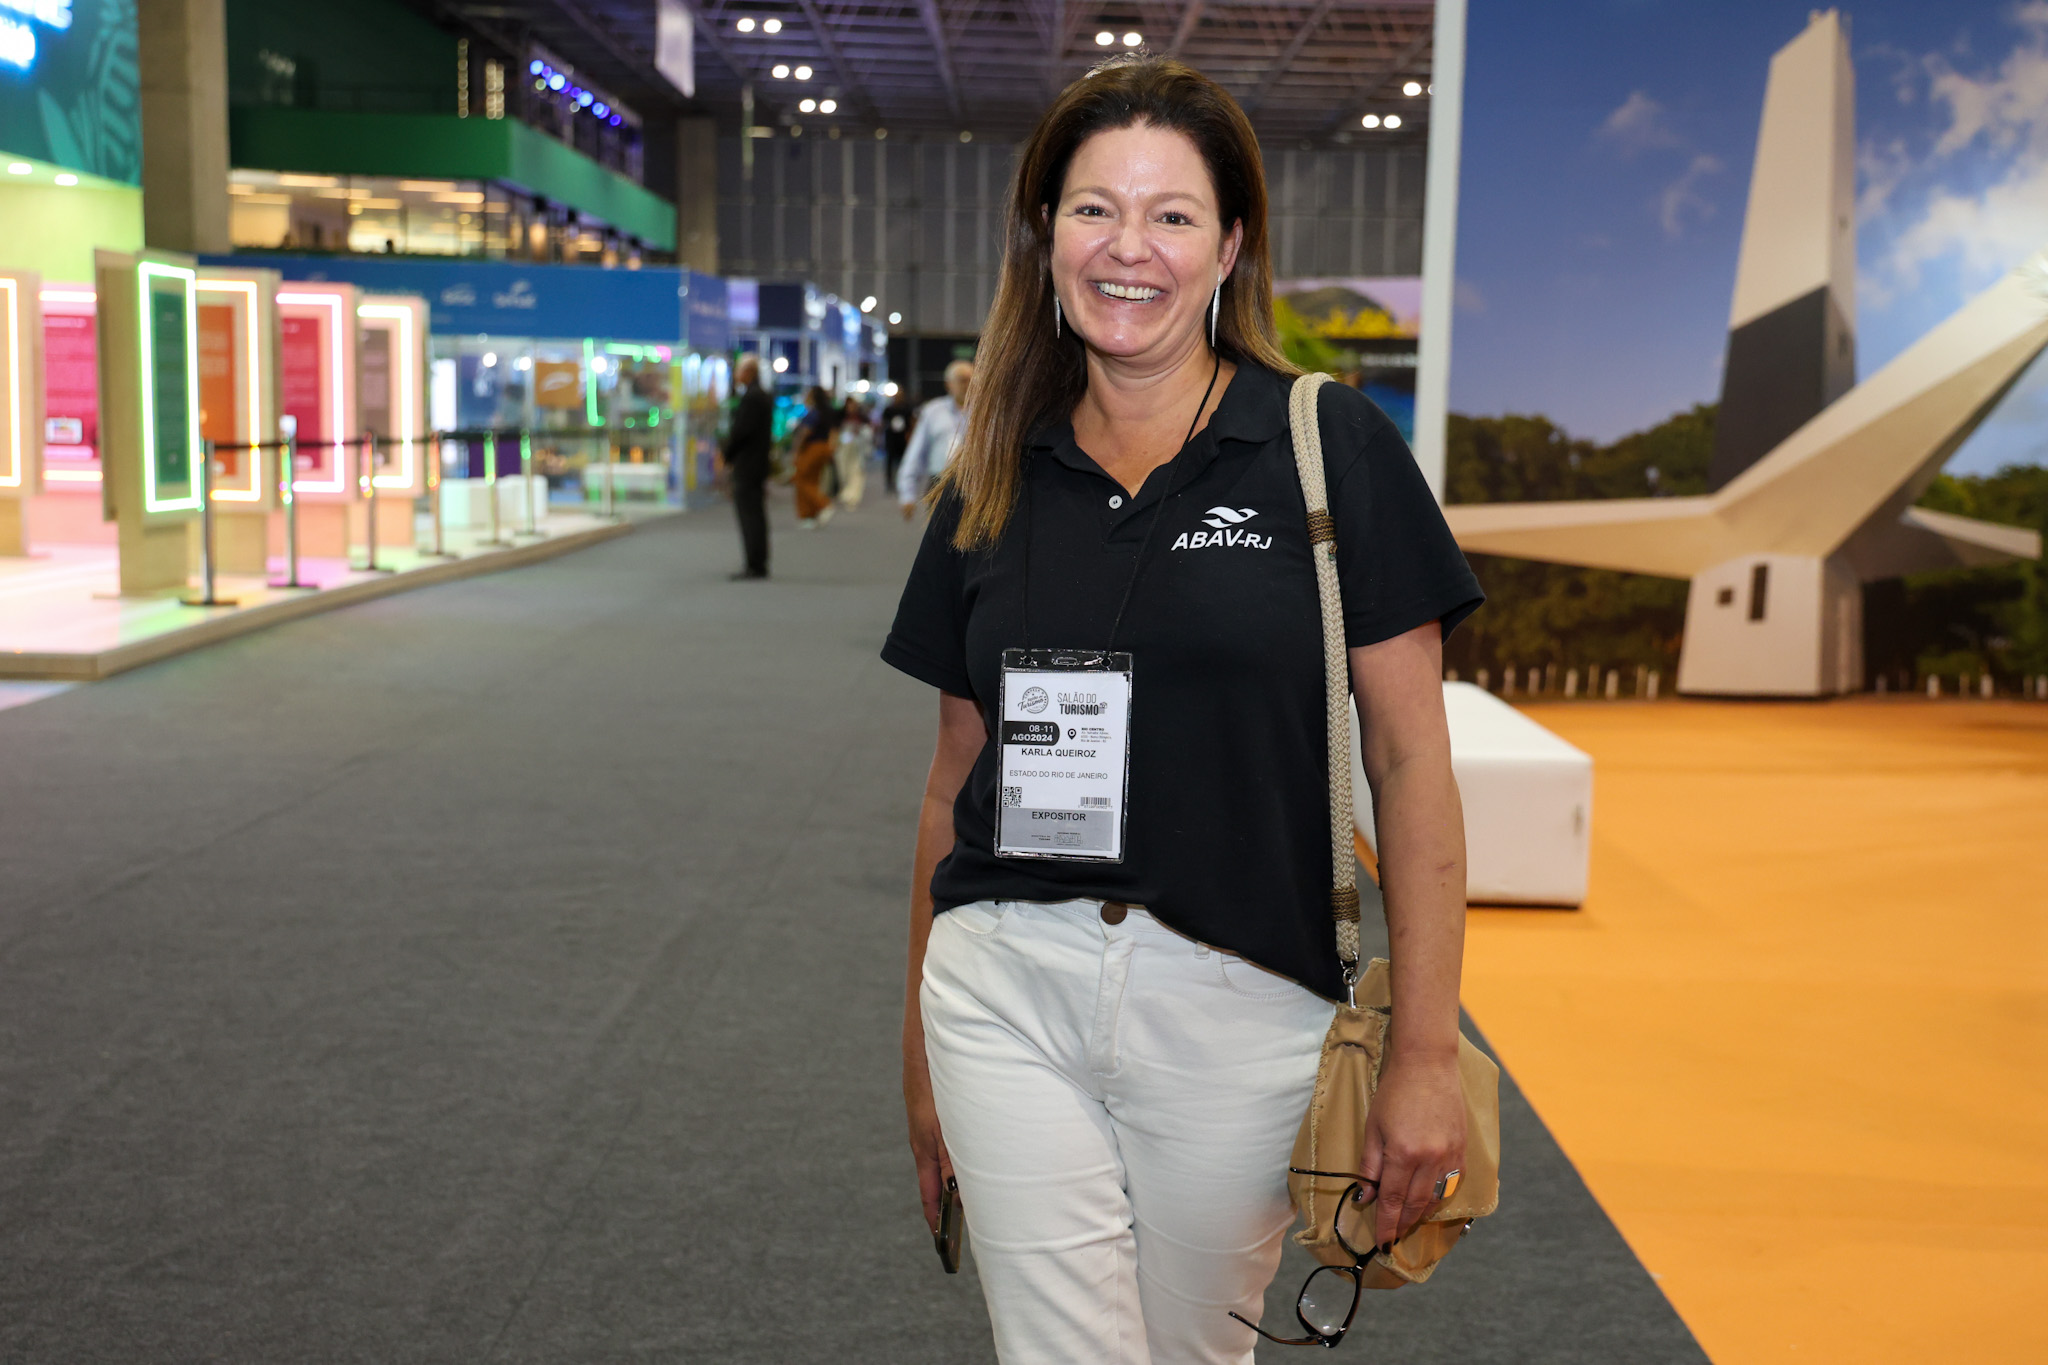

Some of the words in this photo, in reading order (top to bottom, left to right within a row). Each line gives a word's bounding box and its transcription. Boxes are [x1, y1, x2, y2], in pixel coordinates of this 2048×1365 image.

[1171, 529, 1273, 551] ABAV-RJ
[1057, 692, 1084, 704] SALÃO
[1086, 693, 1097, 704] DO
[1060, 703, 1099, 715] TURISMO
[1029, 724, 1054, 734] 08-11
[1011, 734, 1053, 742] AGO2024
[1021, 748, 1053, 757] KARLA
[1055, 748, 1096, 758] QUEIROZ
[1009, 770, 1038, 778] ESTADO
[1039, 770, 1050, 778] DO
[1051, 771, 1063, 779] RIO
[1064, 771, 1075, 779] DE
[1076, 772, 1108, 780] JANEIRO
[1031, 811, 1087, 821] EXPOSITOR
